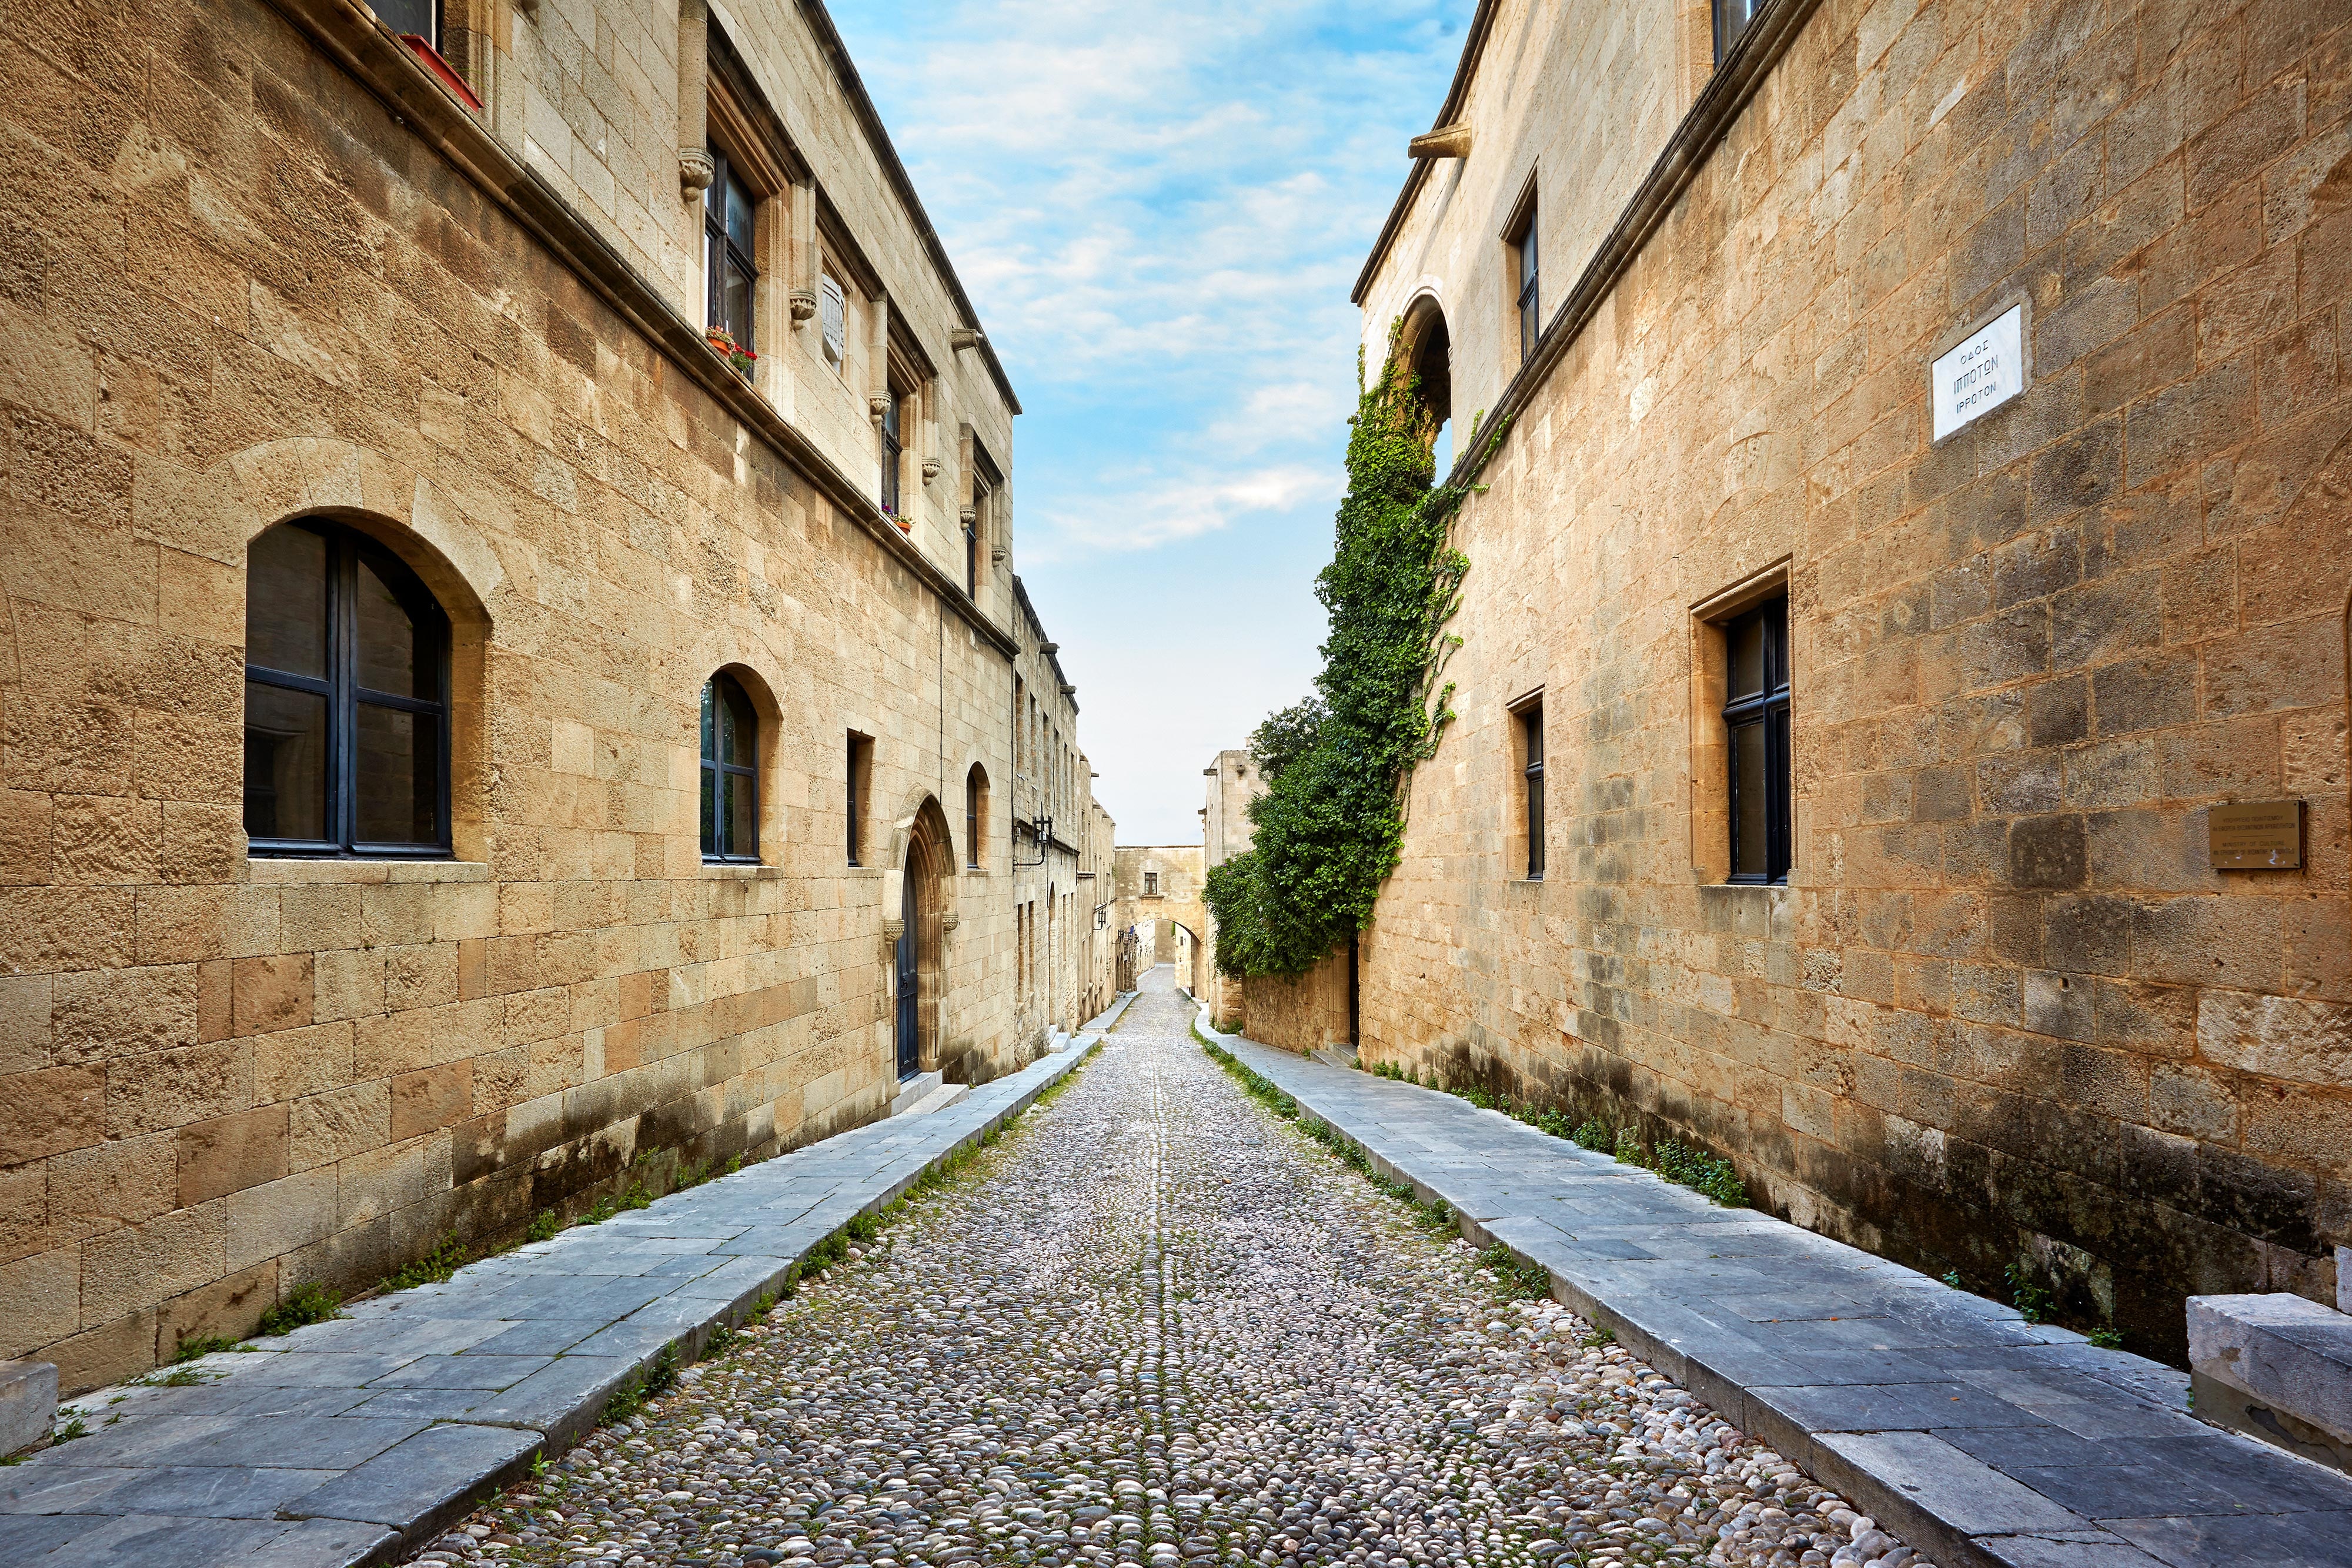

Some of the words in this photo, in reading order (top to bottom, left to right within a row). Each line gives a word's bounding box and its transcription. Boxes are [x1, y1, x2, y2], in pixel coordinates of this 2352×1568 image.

[1960, 339, 1989, 365] ΟΔΟΣ
[1954, 354, 1999, 394] ΙΠΠΟΤΩΝ
[1956, 381, 1996, 414] IPPOTON
